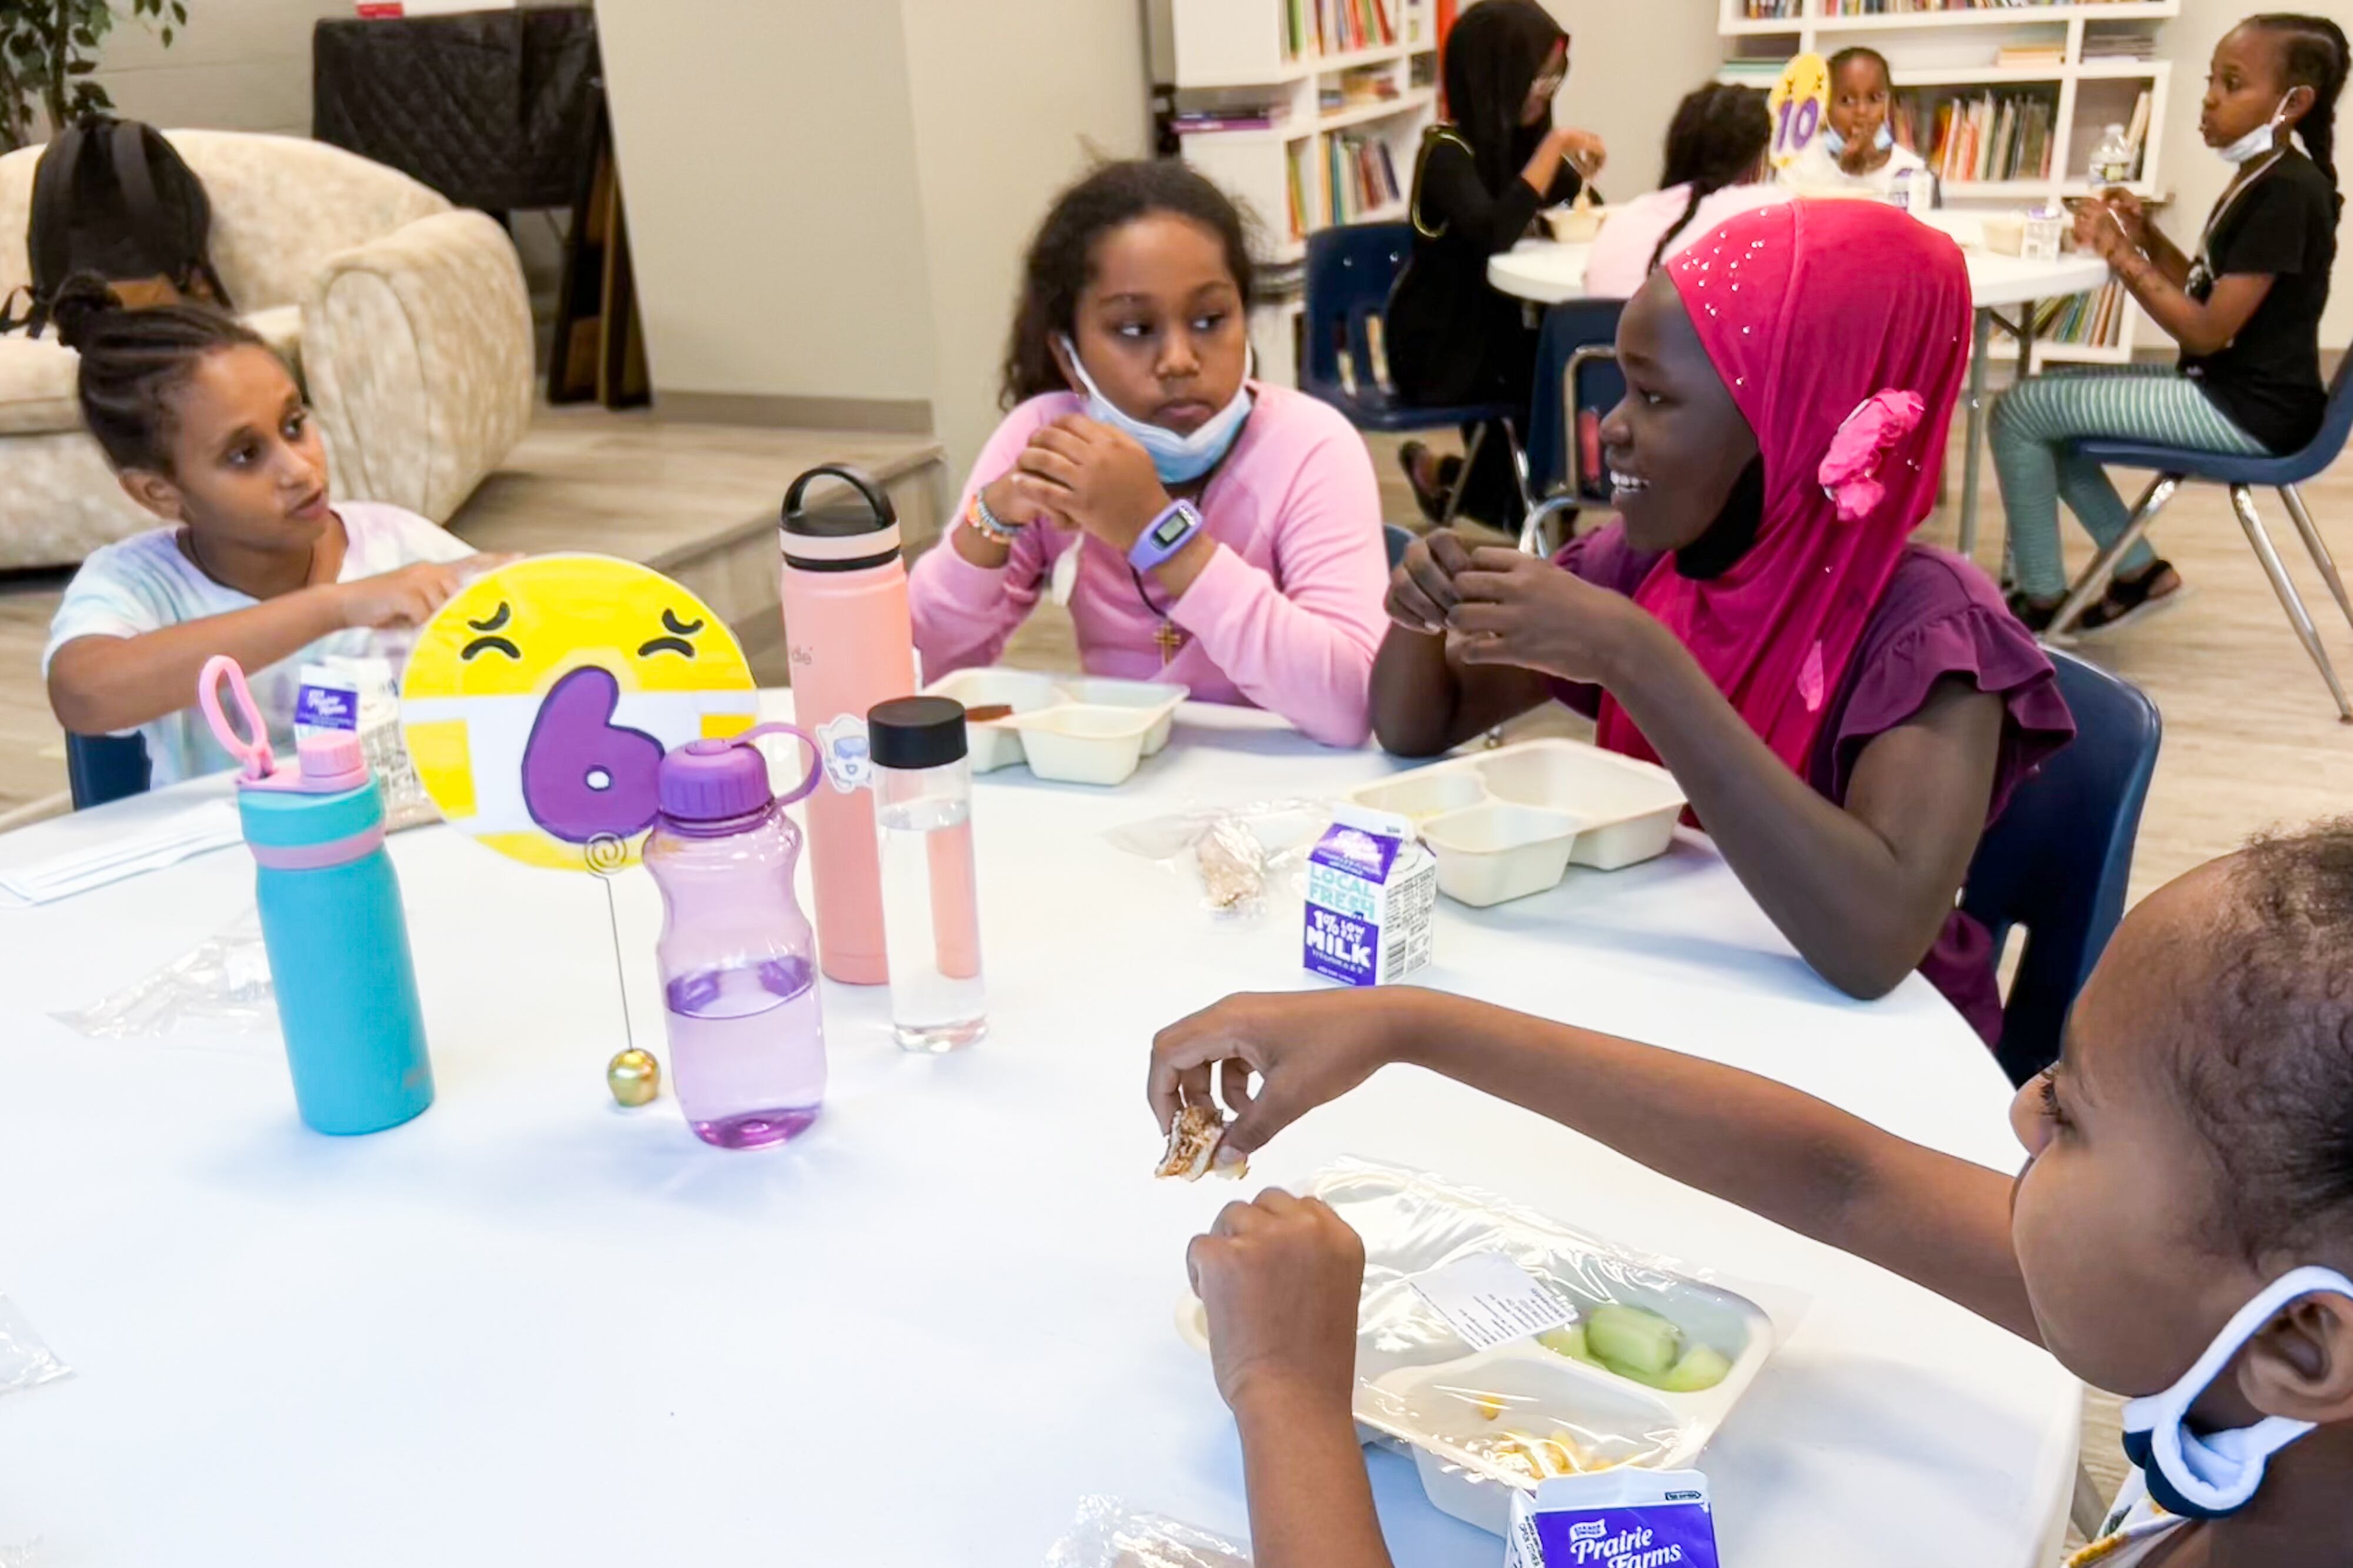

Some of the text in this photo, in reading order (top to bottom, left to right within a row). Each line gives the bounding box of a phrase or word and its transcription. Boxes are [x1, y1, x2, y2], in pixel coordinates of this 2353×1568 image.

[1777, 96, 1818, 153] 10
[521, 665, 666, 844] 6
[1309, 881, 1375, 919] FRESH
[1311, 863, 1375, 899] LOCAL
[1314, 910, 1365, 936] 1% LOW
[1307, 925, 1371, 968] MILK
[1570, 1526, 1654, 1564] Prairie
[1607, 1544, 1682, 1568] Farms
